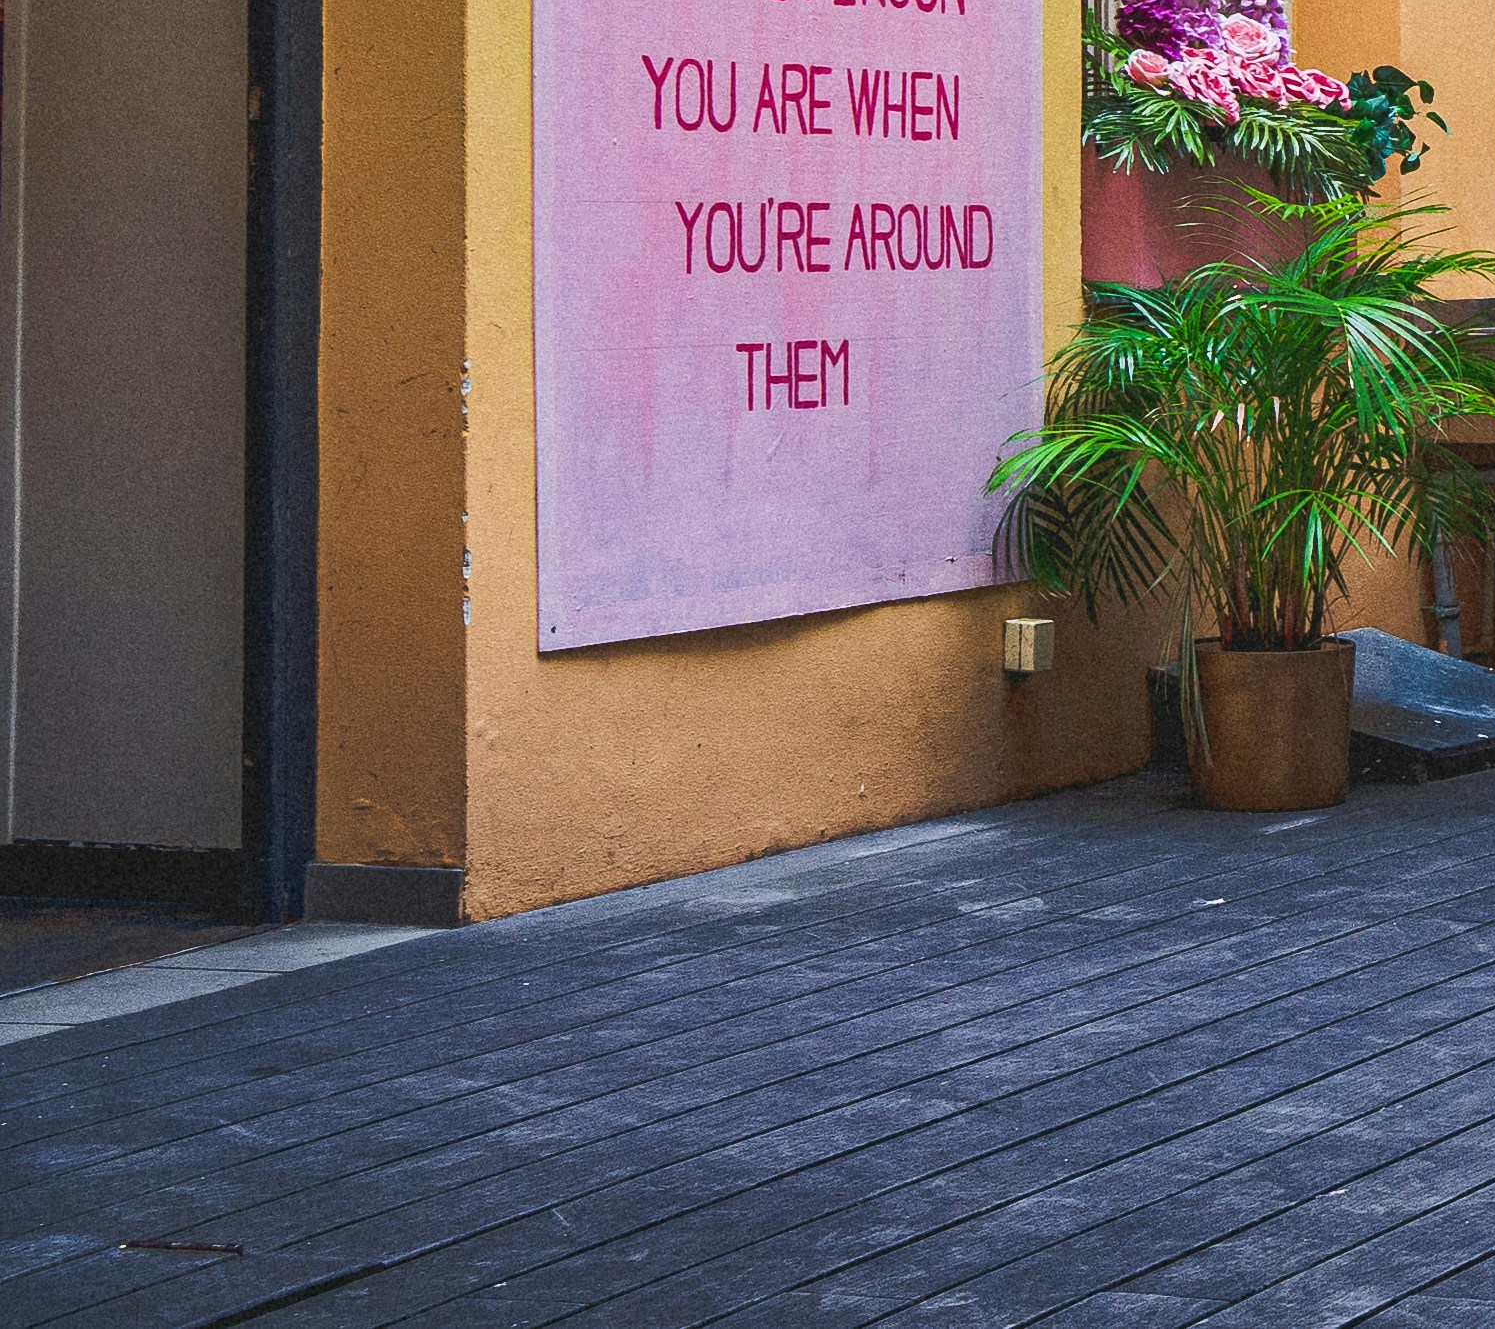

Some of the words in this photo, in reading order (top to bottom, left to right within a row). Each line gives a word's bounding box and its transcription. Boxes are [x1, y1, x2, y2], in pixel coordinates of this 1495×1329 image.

[641, 54, 737, 133] YOU
[752, 63, 833, 136] ARE
[847, 68, 960, 142] WHEN
[674, 197, 831, 275] YOU'RE
[844, 202, 994, 271] AROUND
[735, 339, 849, 412] THEM
